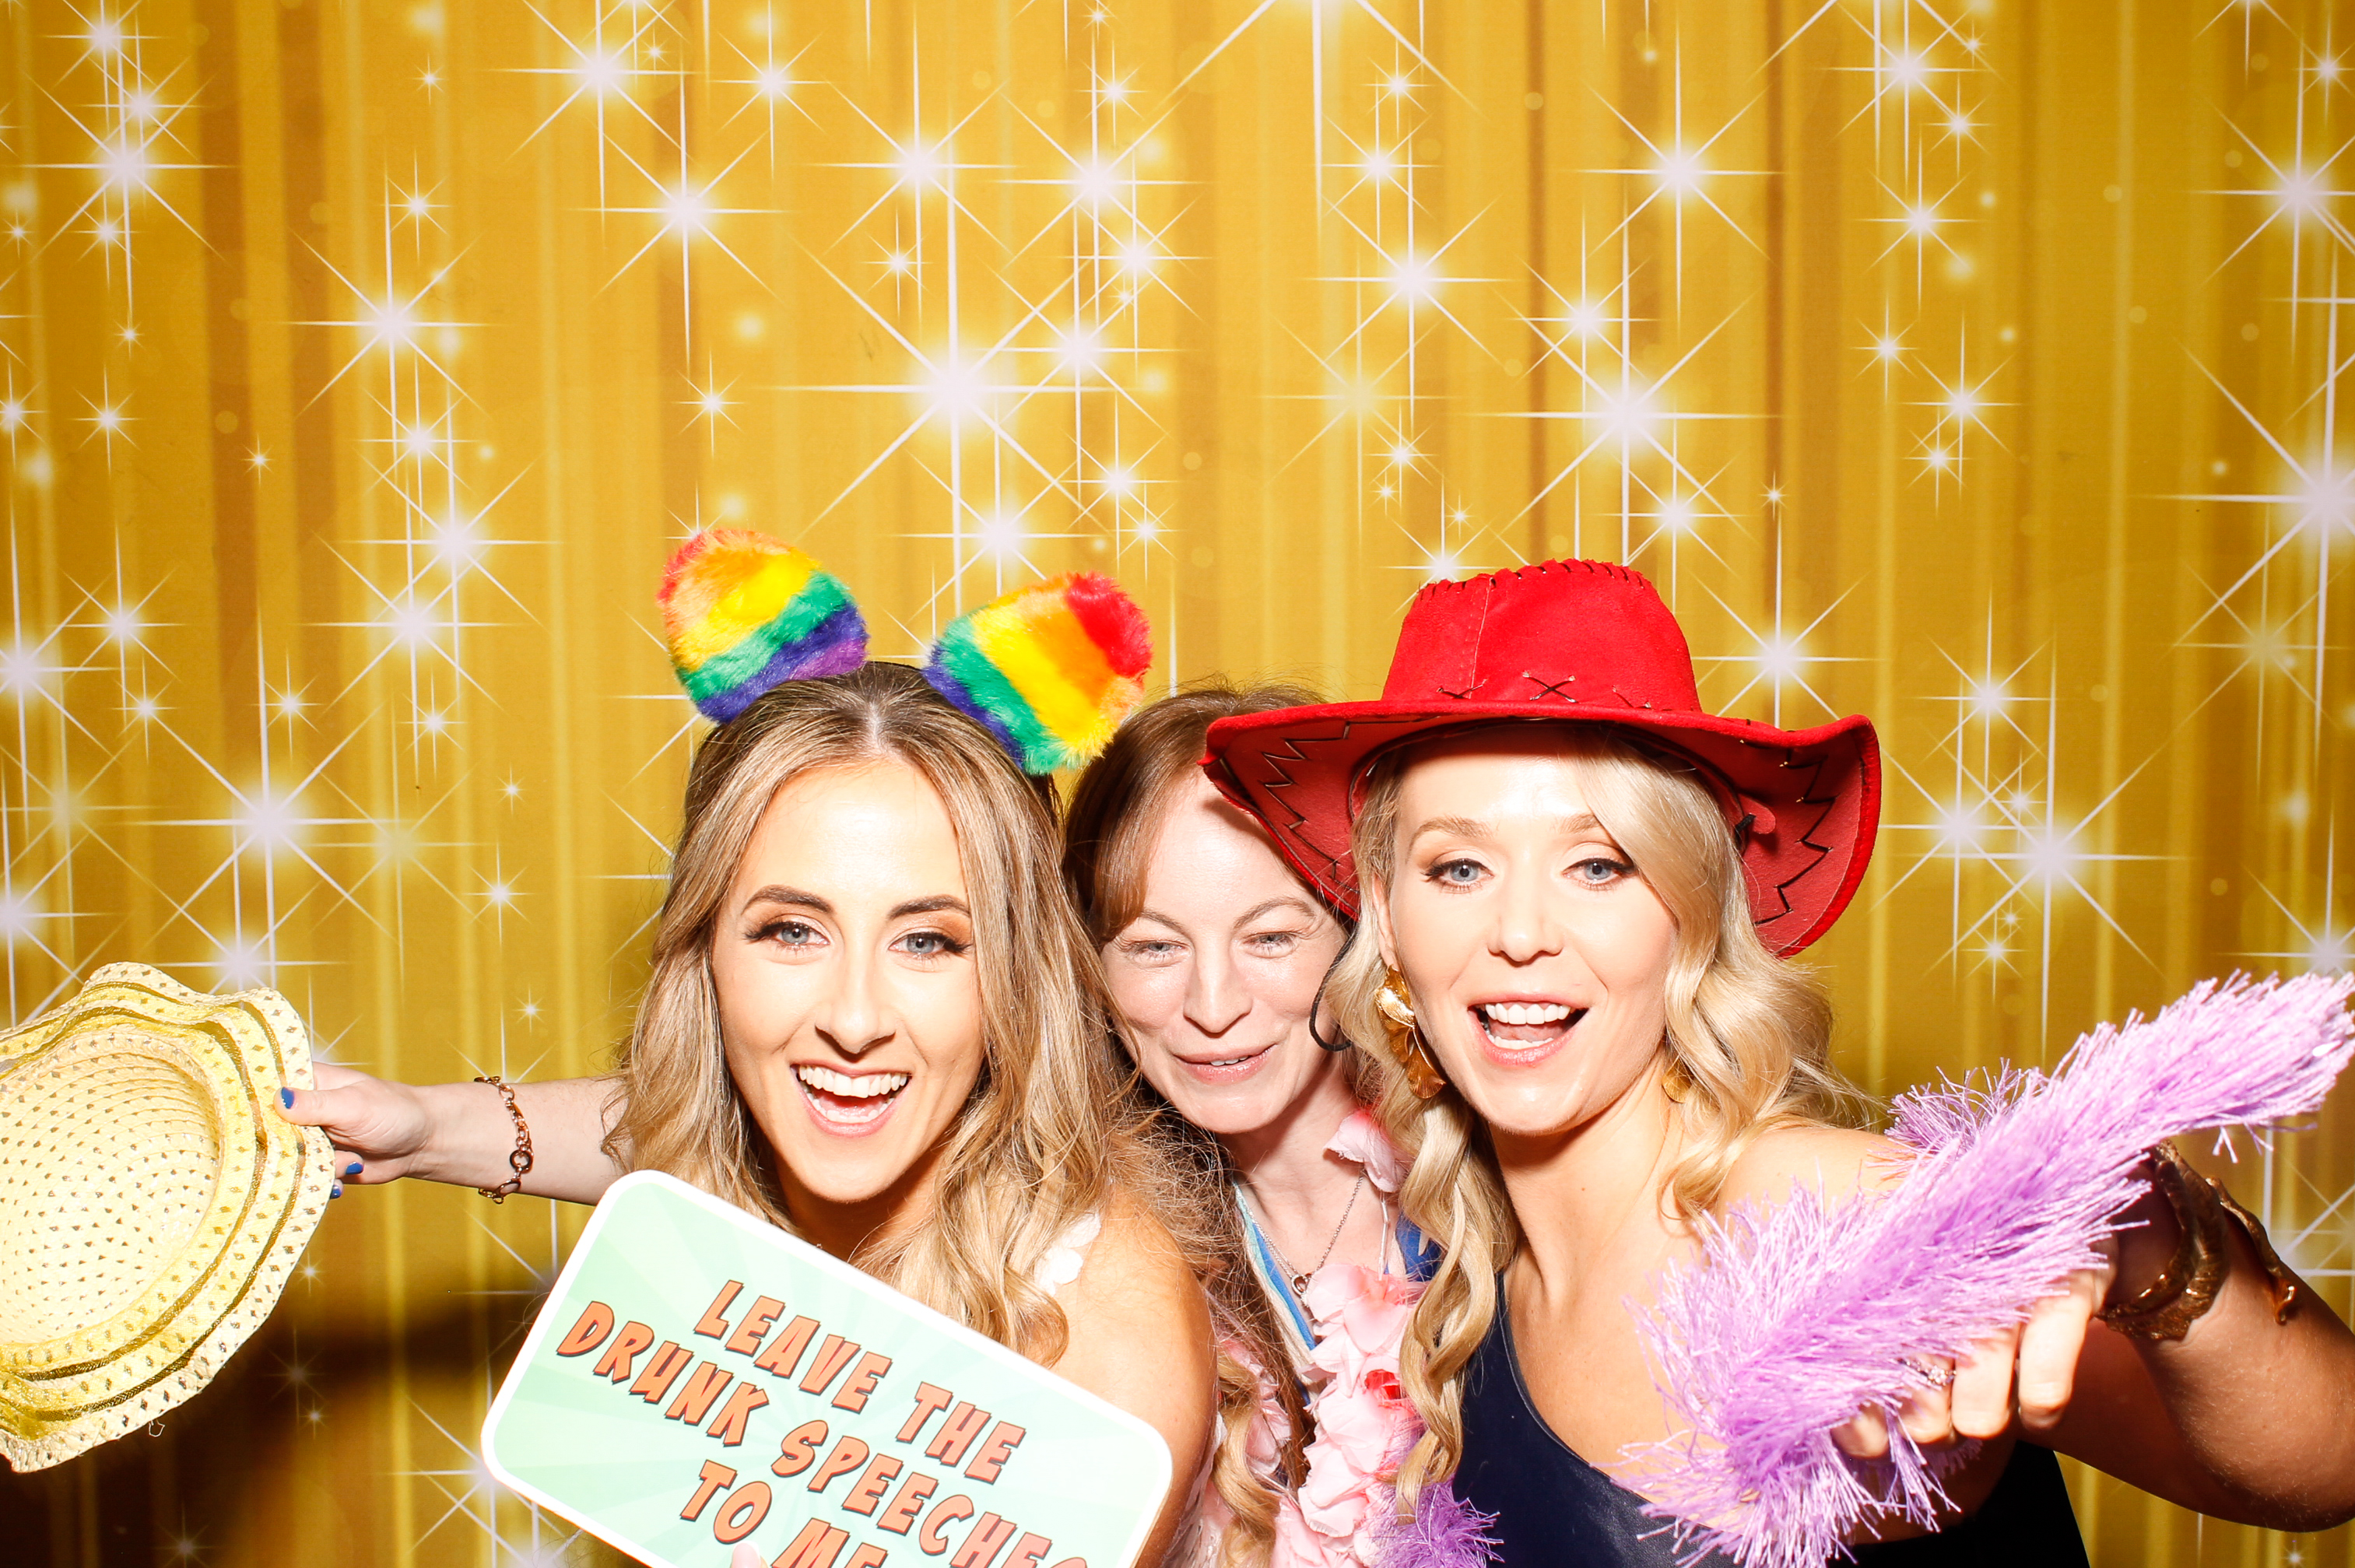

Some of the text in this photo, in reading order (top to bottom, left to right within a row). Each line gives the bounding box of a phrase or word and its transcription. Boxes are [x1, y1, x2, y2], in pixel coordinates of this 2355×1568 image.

[556, 1300, 1088, 1568] DRUNK SPEECHE
[693, 1279, 1027, 1485] LEAVE THE
[679, 1459, 772, 1544] TO
